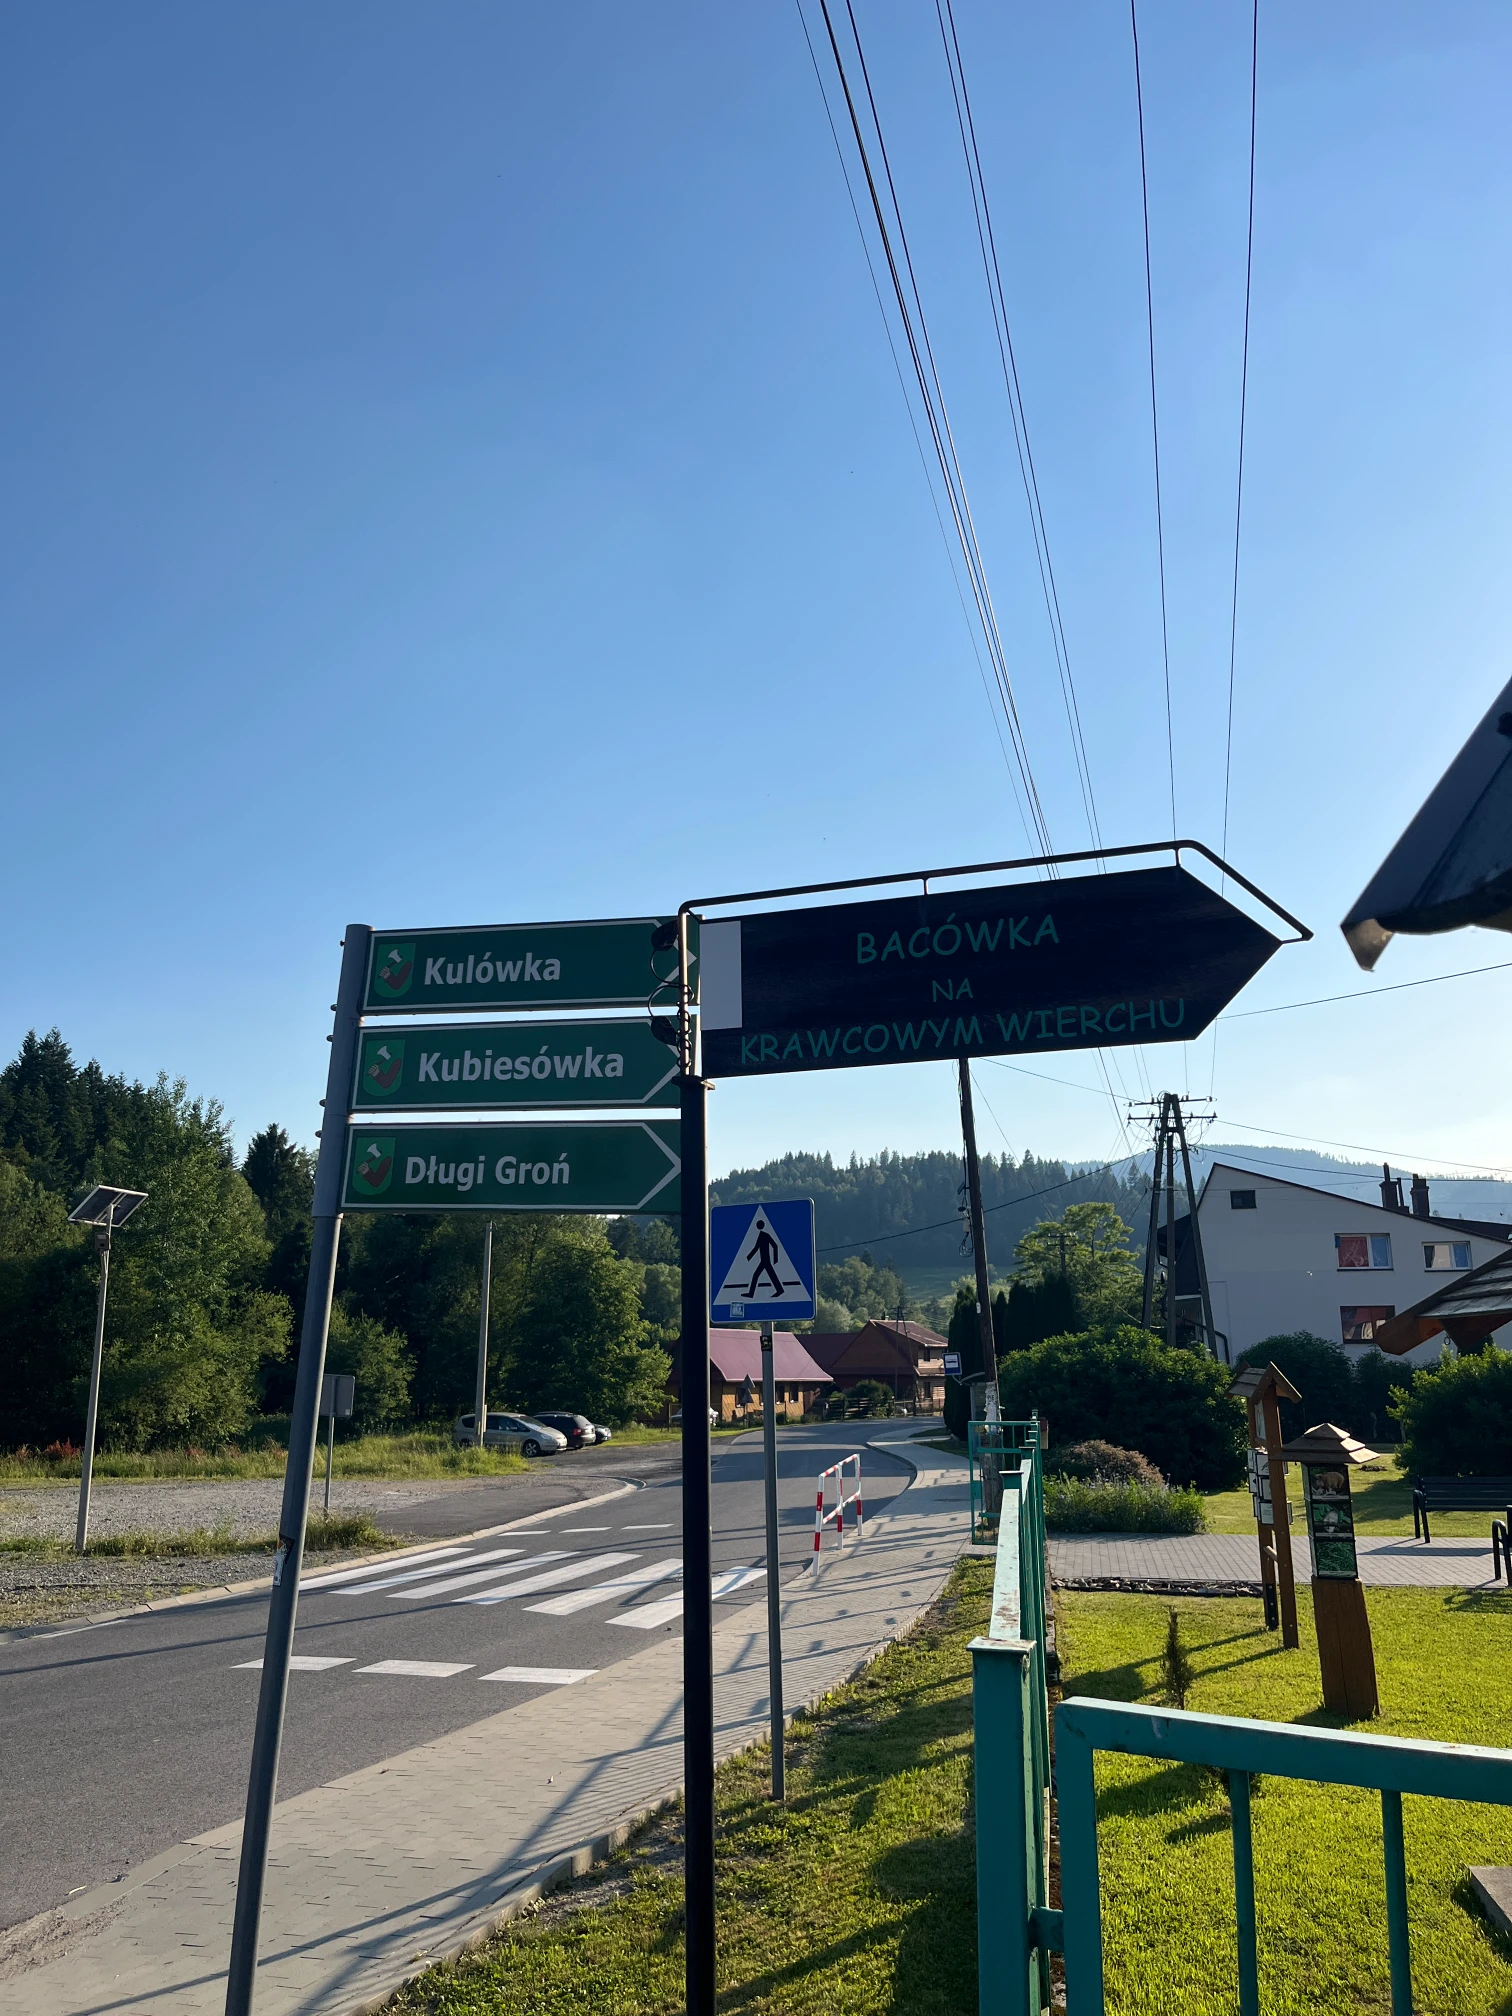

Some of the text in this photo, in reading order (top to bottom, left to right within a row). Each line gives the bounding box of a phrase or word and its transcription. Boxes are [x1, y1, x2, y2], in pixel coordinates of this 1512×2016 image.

[856, 913, 1060, 964] BACÓWKA
[424, 952, 561, 985] Kulówka
[931, 978, 974, 1003] NA
[740, 998, 1185, 1064] KRAWCOWYM WIERCHU
[418, 1045, 624, 1082] Kubiesówka
[405, 1152, 570, 1192] Długi Groń
